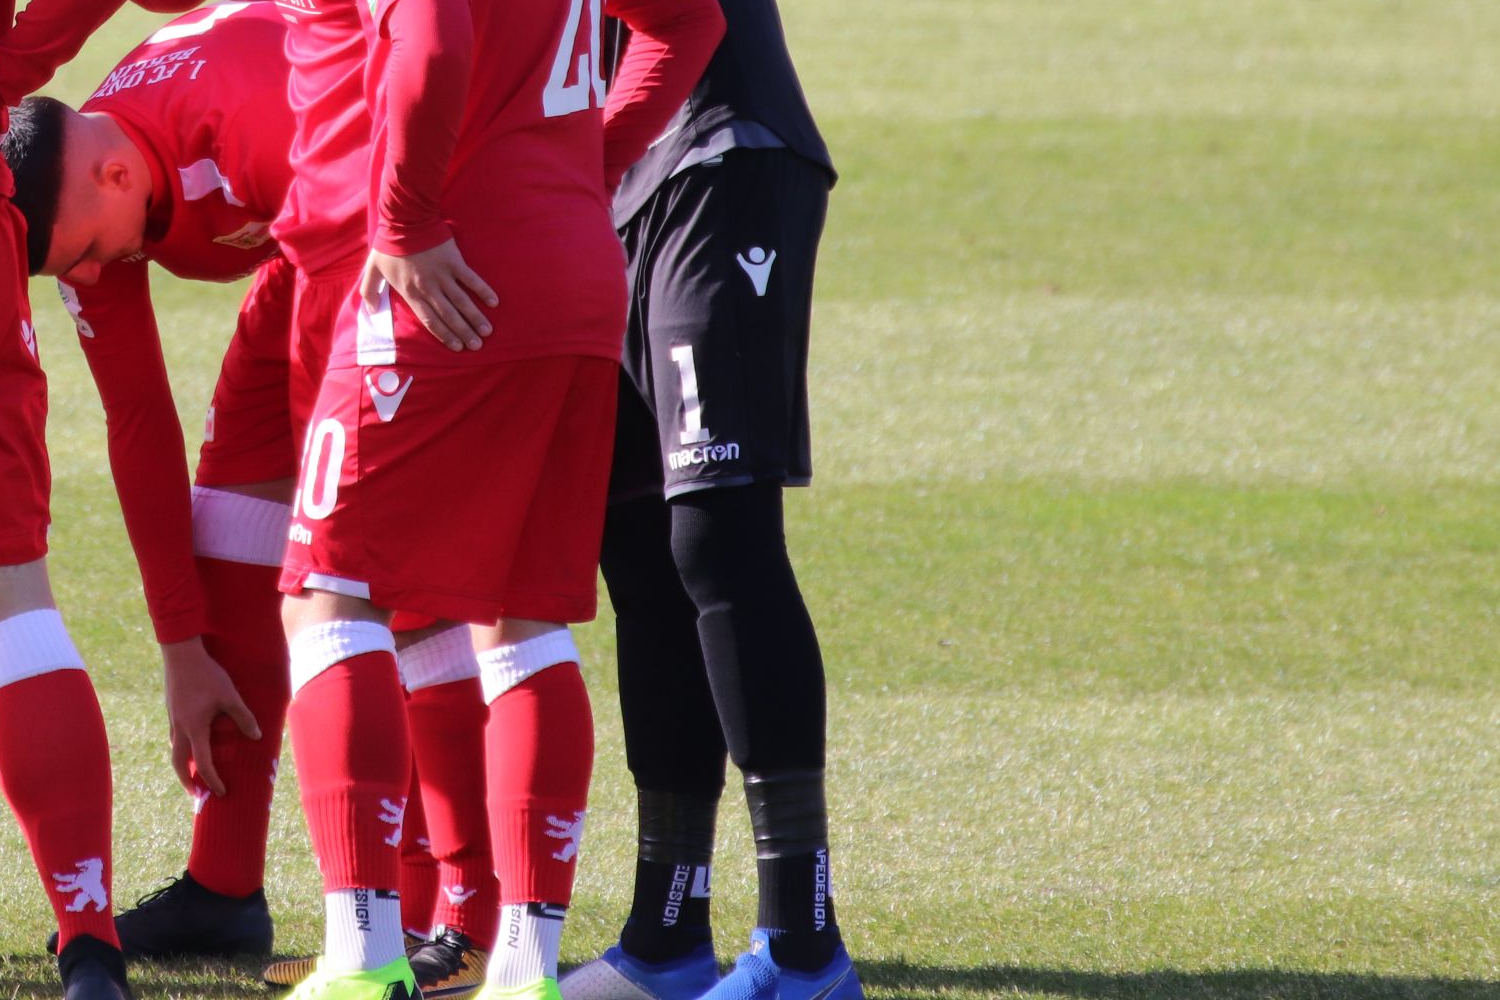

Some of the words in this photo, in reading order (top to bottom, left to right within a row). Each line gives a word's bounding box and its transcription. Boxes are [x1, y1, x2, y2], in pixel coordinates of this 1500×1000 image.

[146, 63, 184, 86] FC
[671, 345, 711, 446] 1
[668, 442, 740, 471] macron
